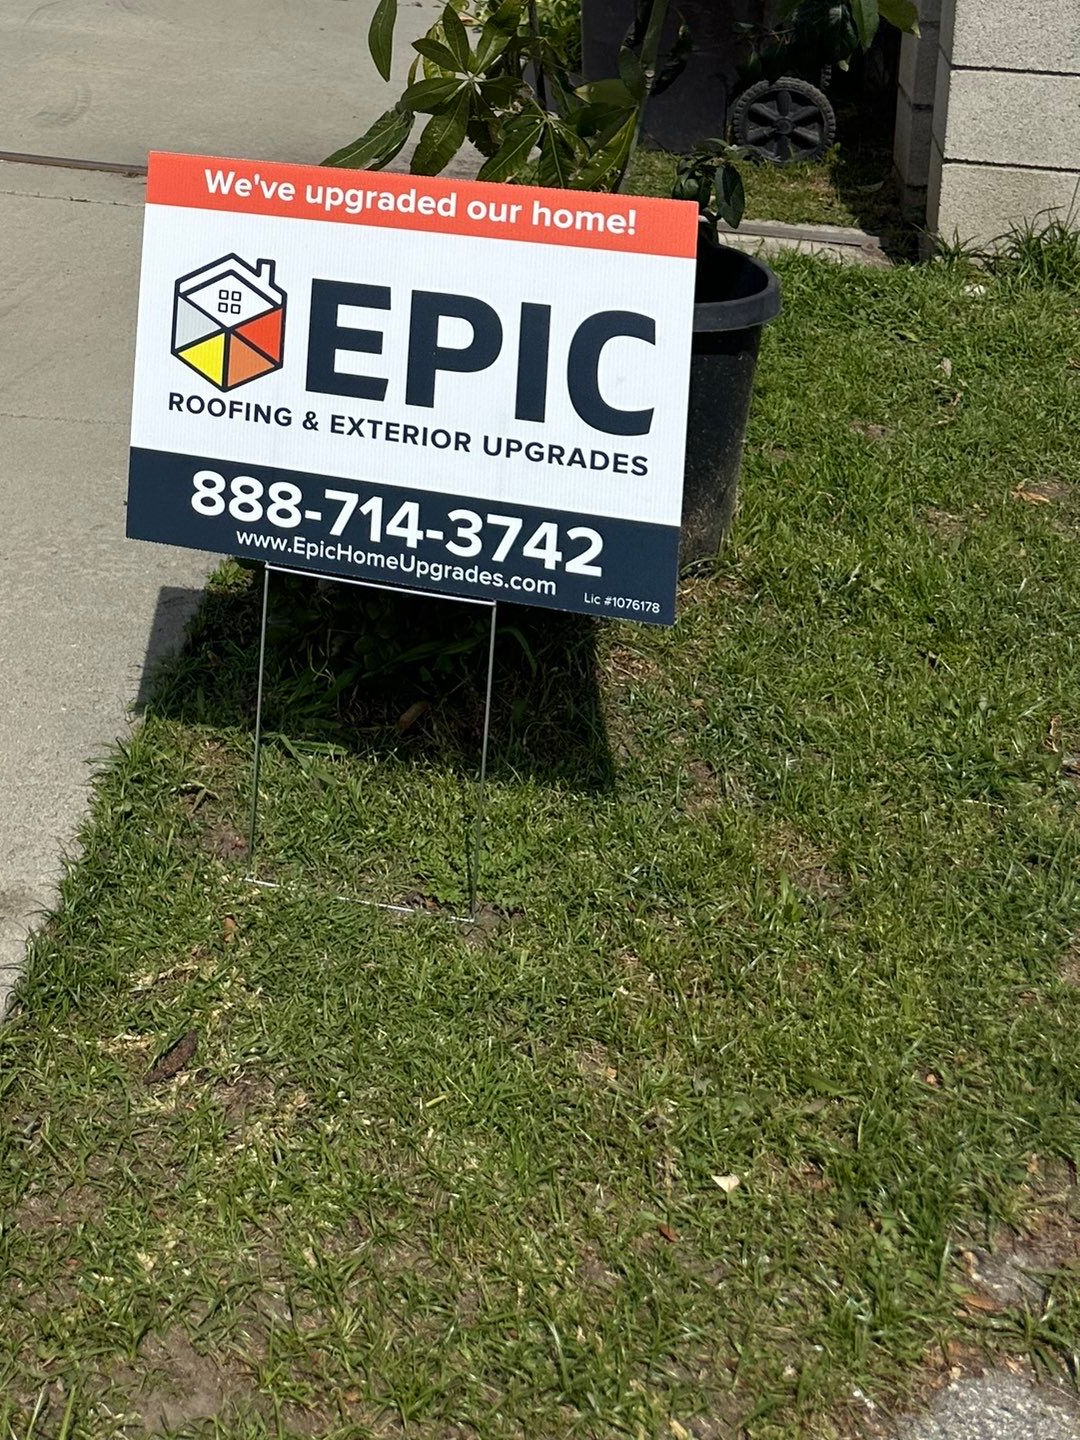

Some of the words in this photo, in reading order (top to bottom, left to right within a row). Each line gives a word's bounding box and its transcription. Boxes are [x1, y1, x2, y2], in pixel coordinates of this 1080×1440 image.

[204, 169, 296, 202] We've
[305, 185, 457, 217] upgraded
[467, 200, 522, 224] our
[532, 200, 636, 236] home!
[305, 277, 656, 437] EPIC
[168, 391, 292, 427] ROOFING
[302, 410, 319, 432] &
[330, 414, 472, 453] EXTERIOR
[483, 435, 648, 477] UPGRADES
[191, 470, 603, 578] 888-714-3742
[236, 530, 556, 596] www.EpicHomeUpgrades.com
[584, 592, 601, 605] Lic
[604, 596, 660, 614] #1076178
